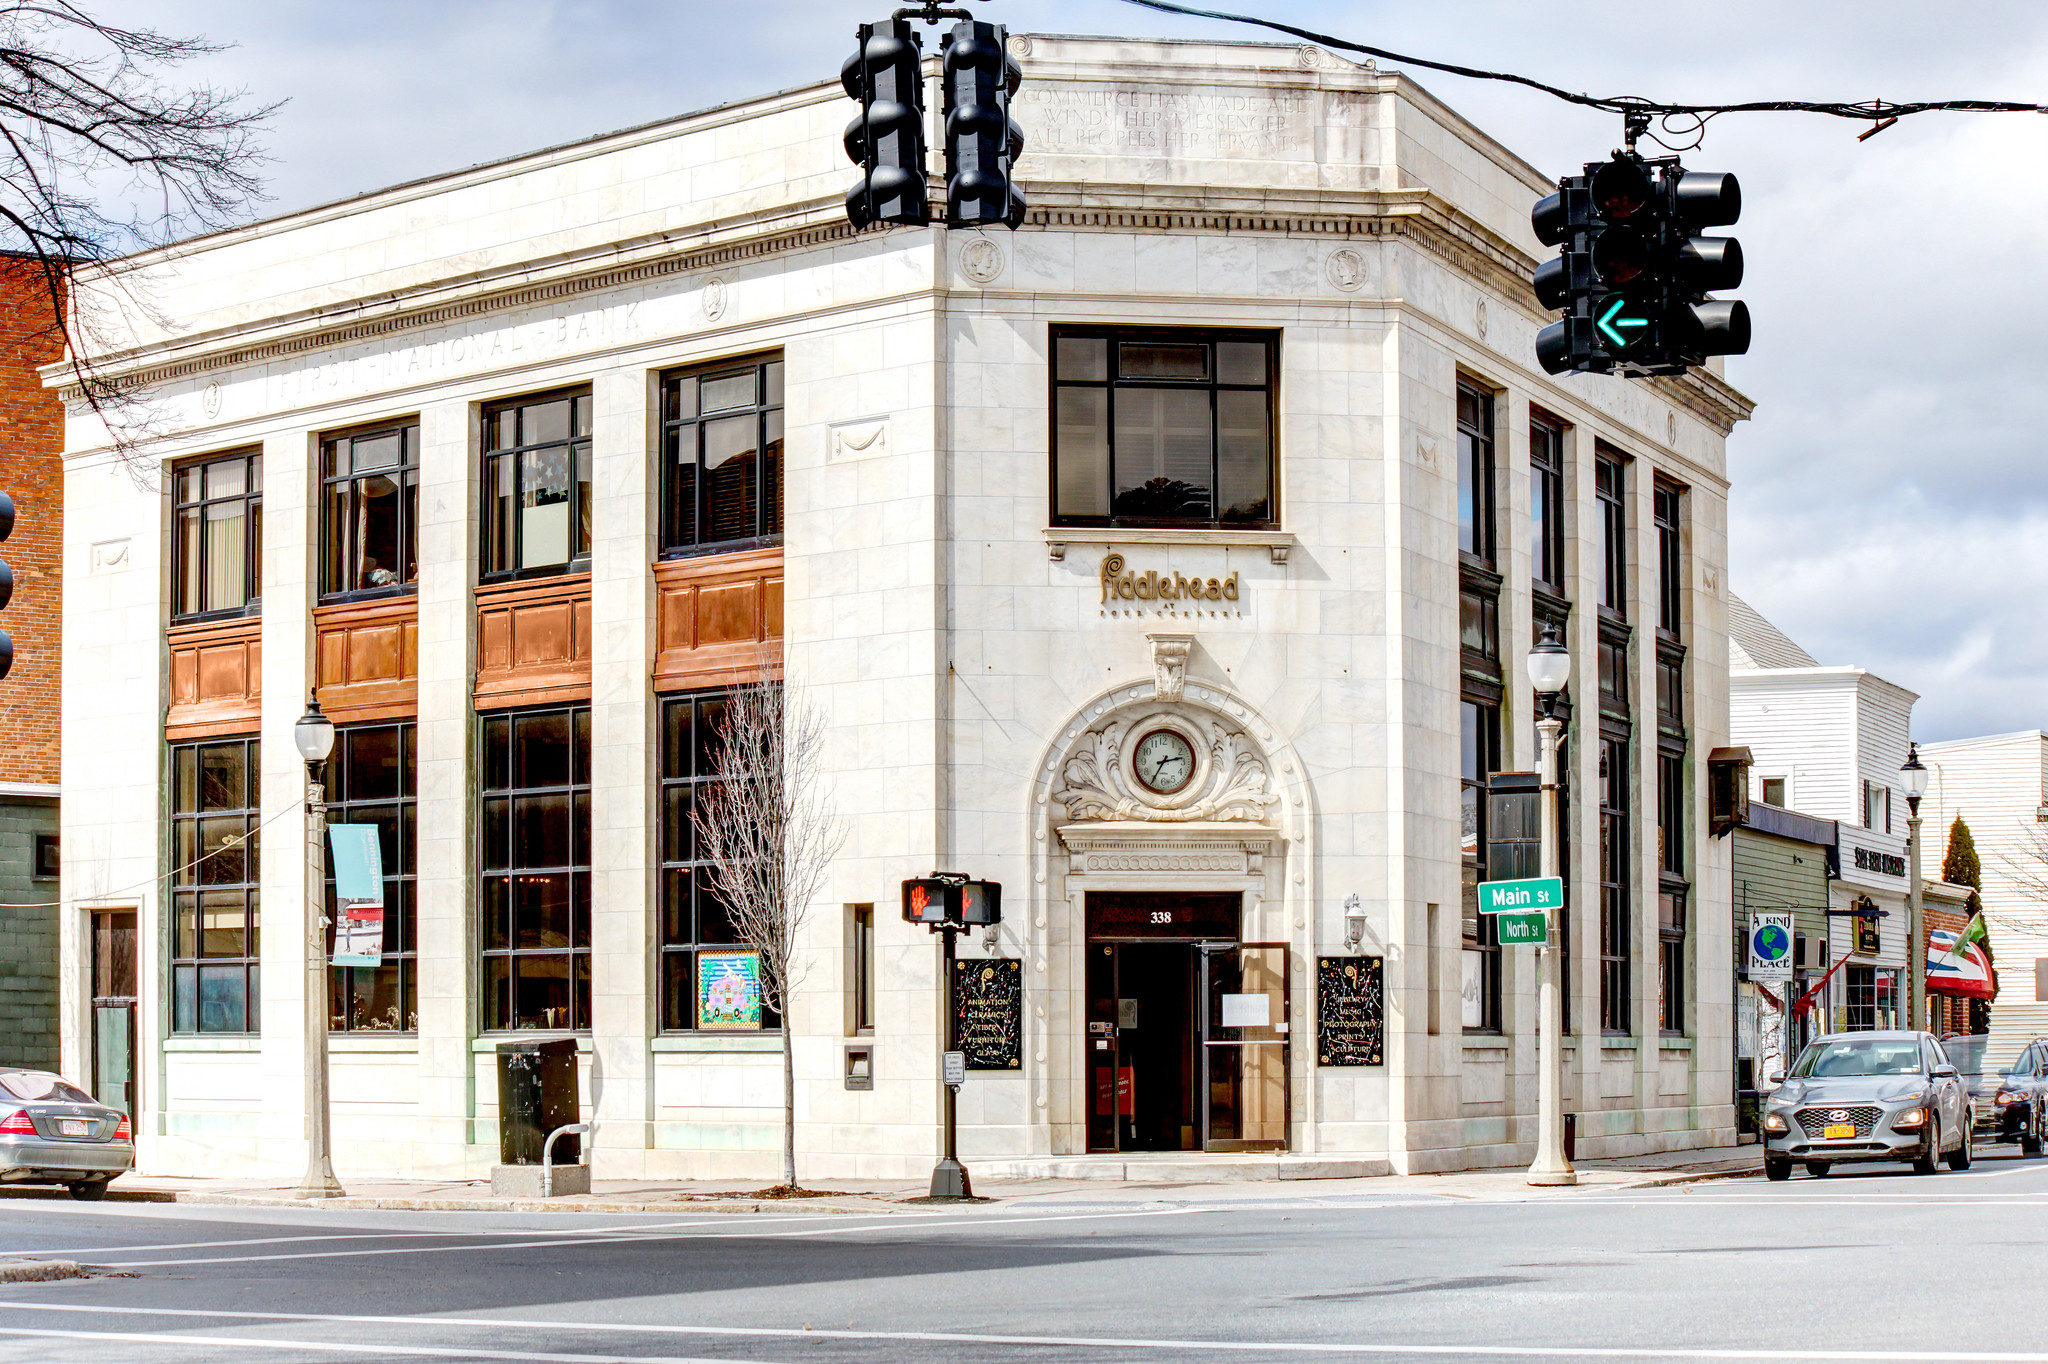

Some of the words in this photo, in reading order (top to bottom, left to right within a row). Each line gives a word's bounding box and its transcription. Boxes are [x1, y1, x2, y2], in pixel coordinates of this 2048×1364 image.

[1023, 88, 1139, 108] COMMERCE
[1149, 92, 1189, 110] HAS
[1197, 94, 1258, 112] MADE
[1267, 97, 1307, 114] ALL
[1043, 108, 1113, 126] WINDS
[1125, 111, 1162, 128] HER
[1174, 112, 1286, 132] MESSENGER
[1030, 128, 1067, 144] ALL
[1075, 128, 1156, 148] PEOPLES
[1165, 131, 1200, 149] HER
[1207, 133, 1299, 152] SERVANTS
[280, 357, 360, 398] FIRST
[385, 325, 523, 377] NATIONAL
[556, 301, 641, 343] BANK
[1151, 739, 1158, 748] 11
[1160, 736, 1168, 746] 12
[1171, 740, 1175, 748] 1
[1143, 747, 1152, 756] 10
[1178, 747, 1183, 756] 2
[1141, 757, 1147, 765] 9
[1143, 767, 1149, 776] 8
[1177, 767, 1183, 776] 4
[1160, 777, 1166, 786] 6
[1170, 775, 1176, 783] 5
[367, 828, 380, 895] Bennington
[1492, 887, 1531, 906] Main
[1537, 890, 1550, 903] St
[1150, 911, 1172, 924] 338
[1752, 916, 1760, 930] A
[1765, 916, 1791, 930] KIND
[1506, 920, 1530, 938] North
[1531, 925, 1539, 937] St
[1751, 955, 1791, 969] PLACE
[970, 1010, 1007, 1019] CERAMICS
[976, 1024, 998, 1032] FIBER
[1324, 1021, 1377, 1029] PHOTOGRAPHY
